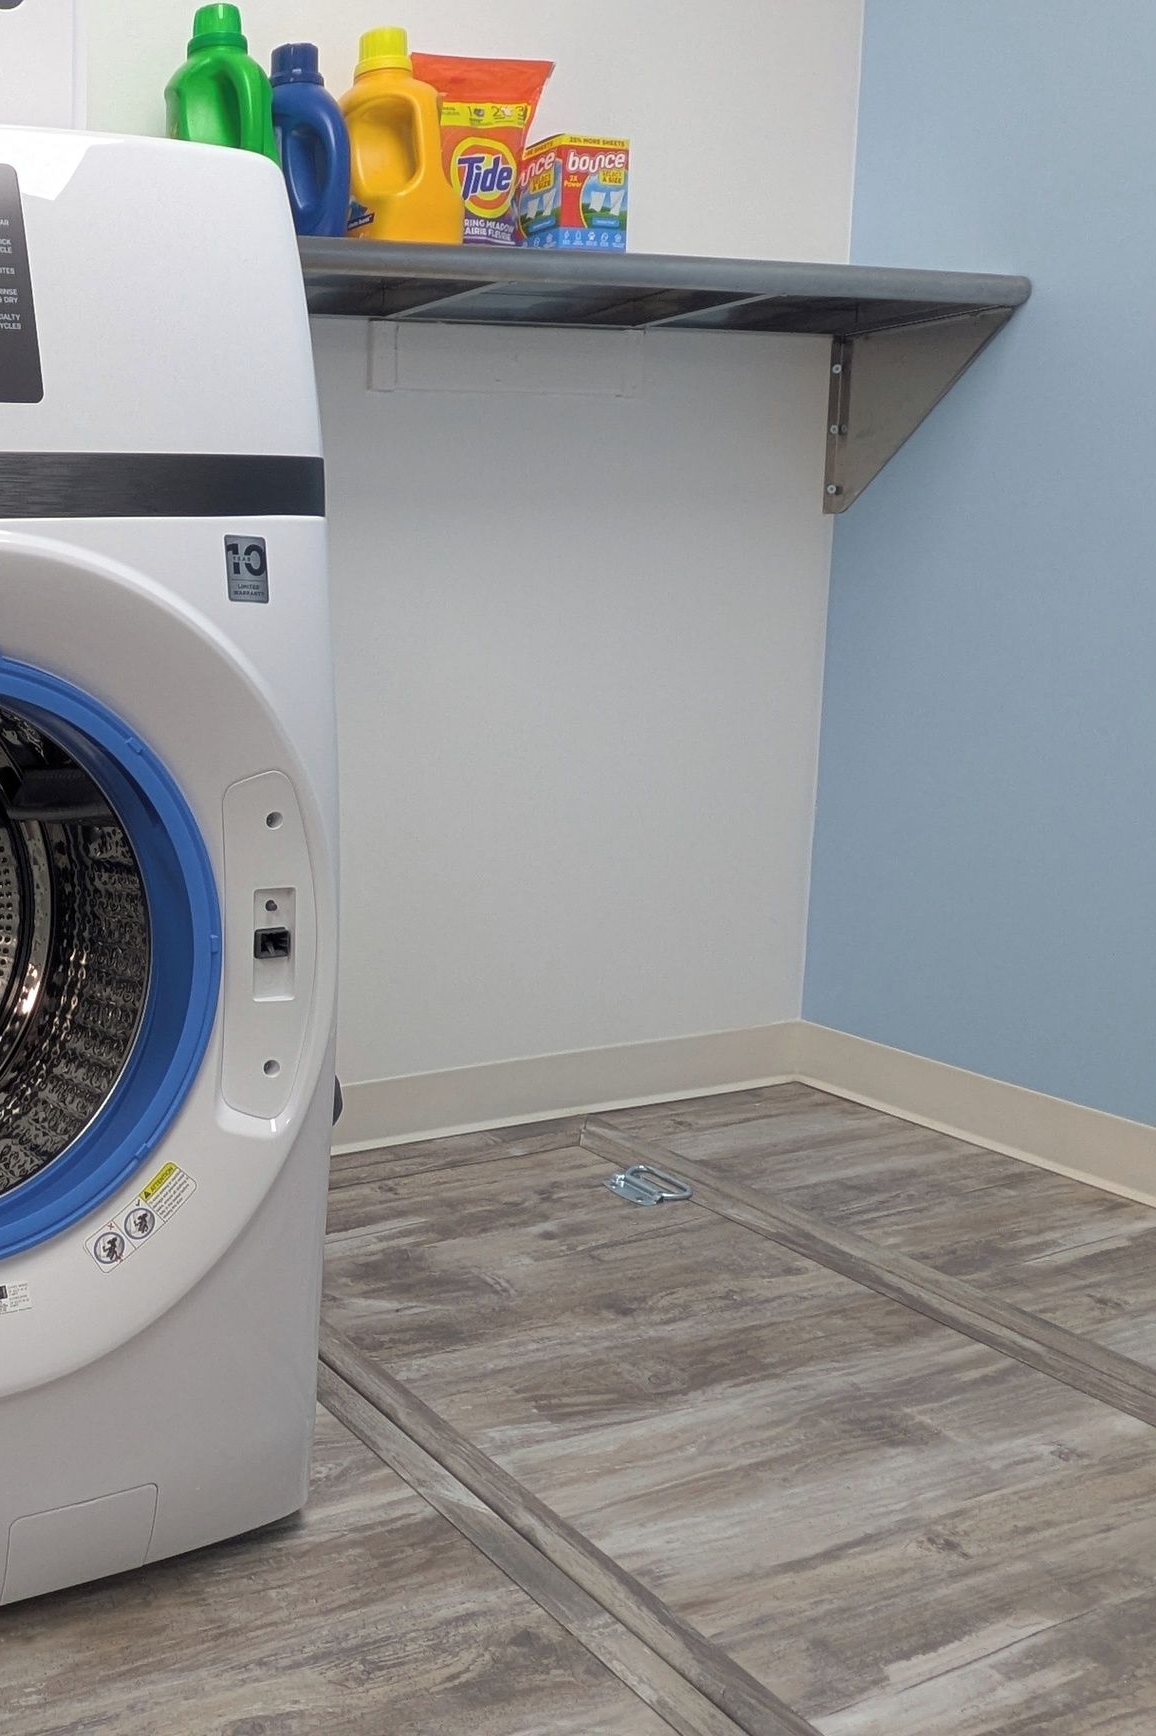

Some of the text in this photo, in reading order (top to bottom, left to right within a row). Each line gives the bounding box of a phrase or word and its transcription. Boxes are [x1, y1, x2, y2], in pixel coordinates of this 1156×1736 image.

[602, 139, 625, 147] SHEETS
[567, 150, 626, 173] bounce
[457, 156, 513, 200] Tide
[4, 296, 19, 304] DRY
[226, 543, 266, 577] 10
